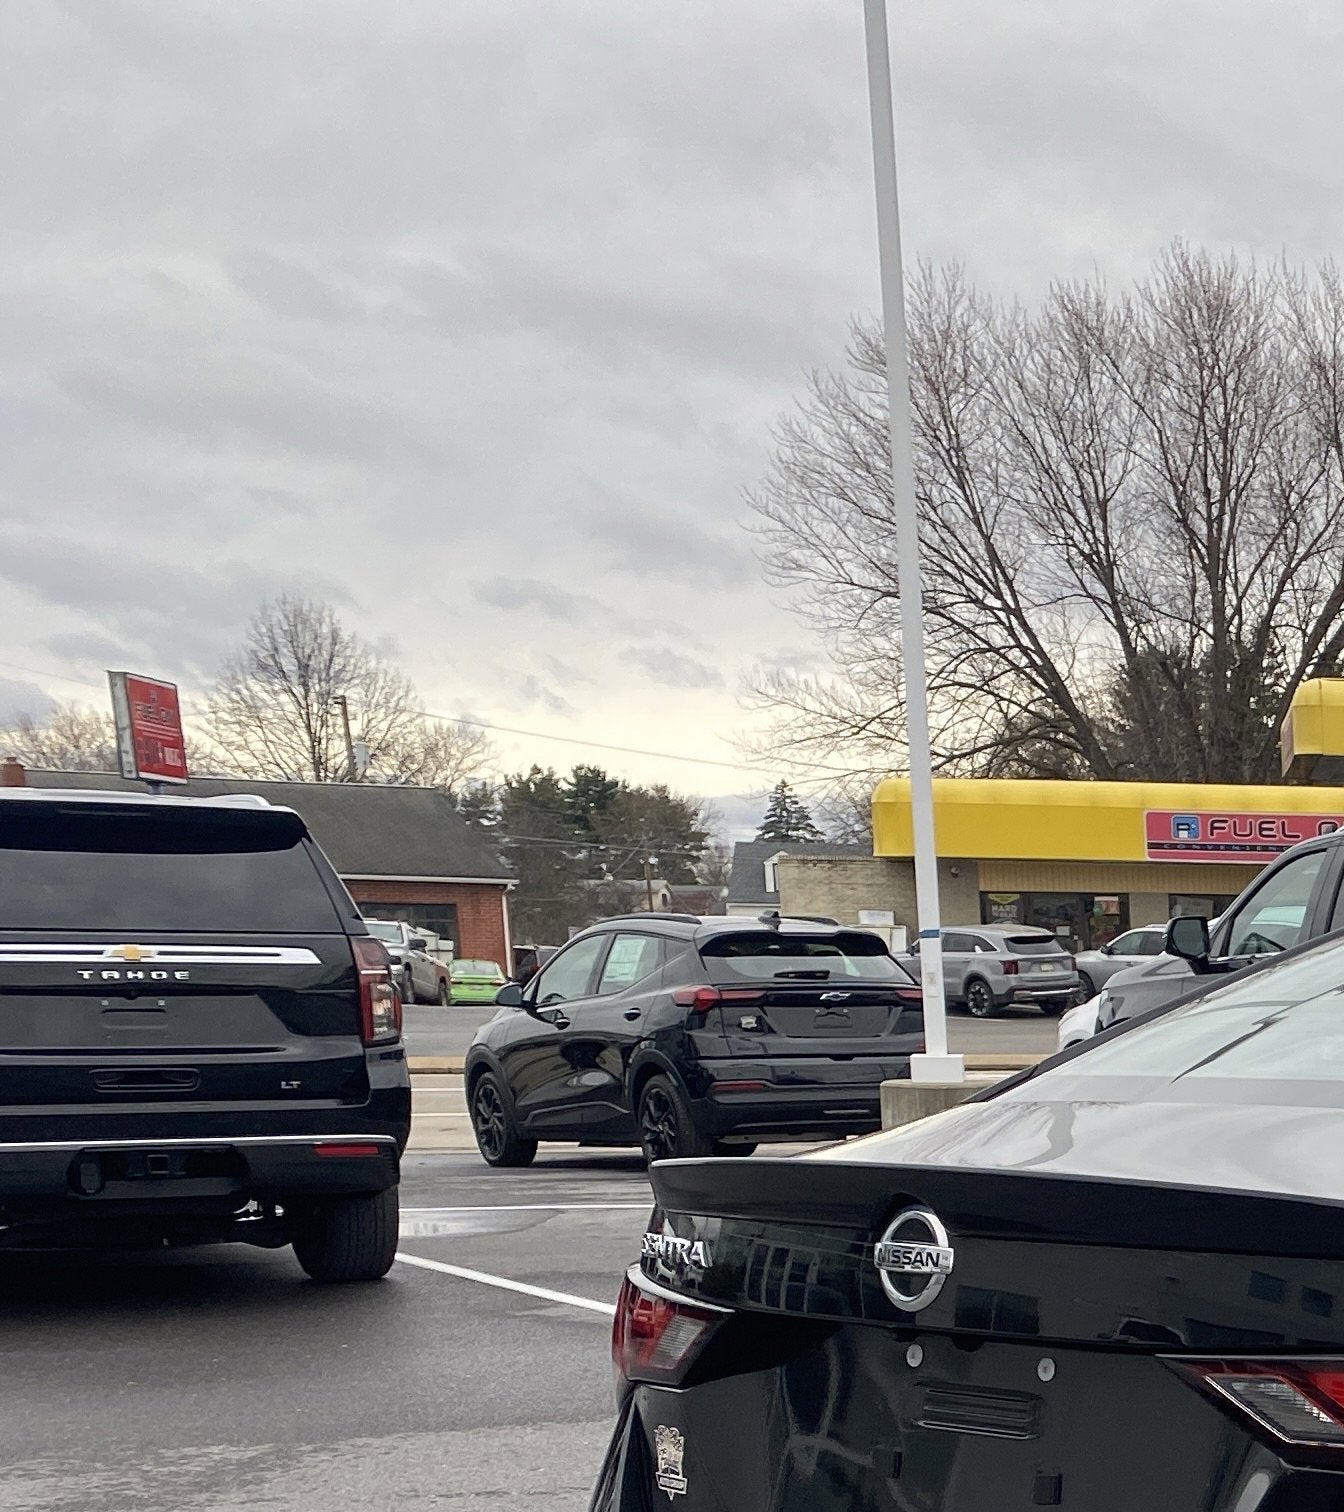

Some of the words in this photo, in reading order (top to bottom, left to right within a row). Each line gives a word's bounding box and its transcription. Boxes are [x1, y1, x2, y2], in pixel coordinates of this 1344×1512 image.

[1208, 818, 1302, 839] FUEL
[1163, 843, 1289, 852] CONVENIEN
[77, 970, 190, 980] TAHOE
[280, 1080, 302, 1089] LT
[878, 1246, 940, 1268] NISSAN
